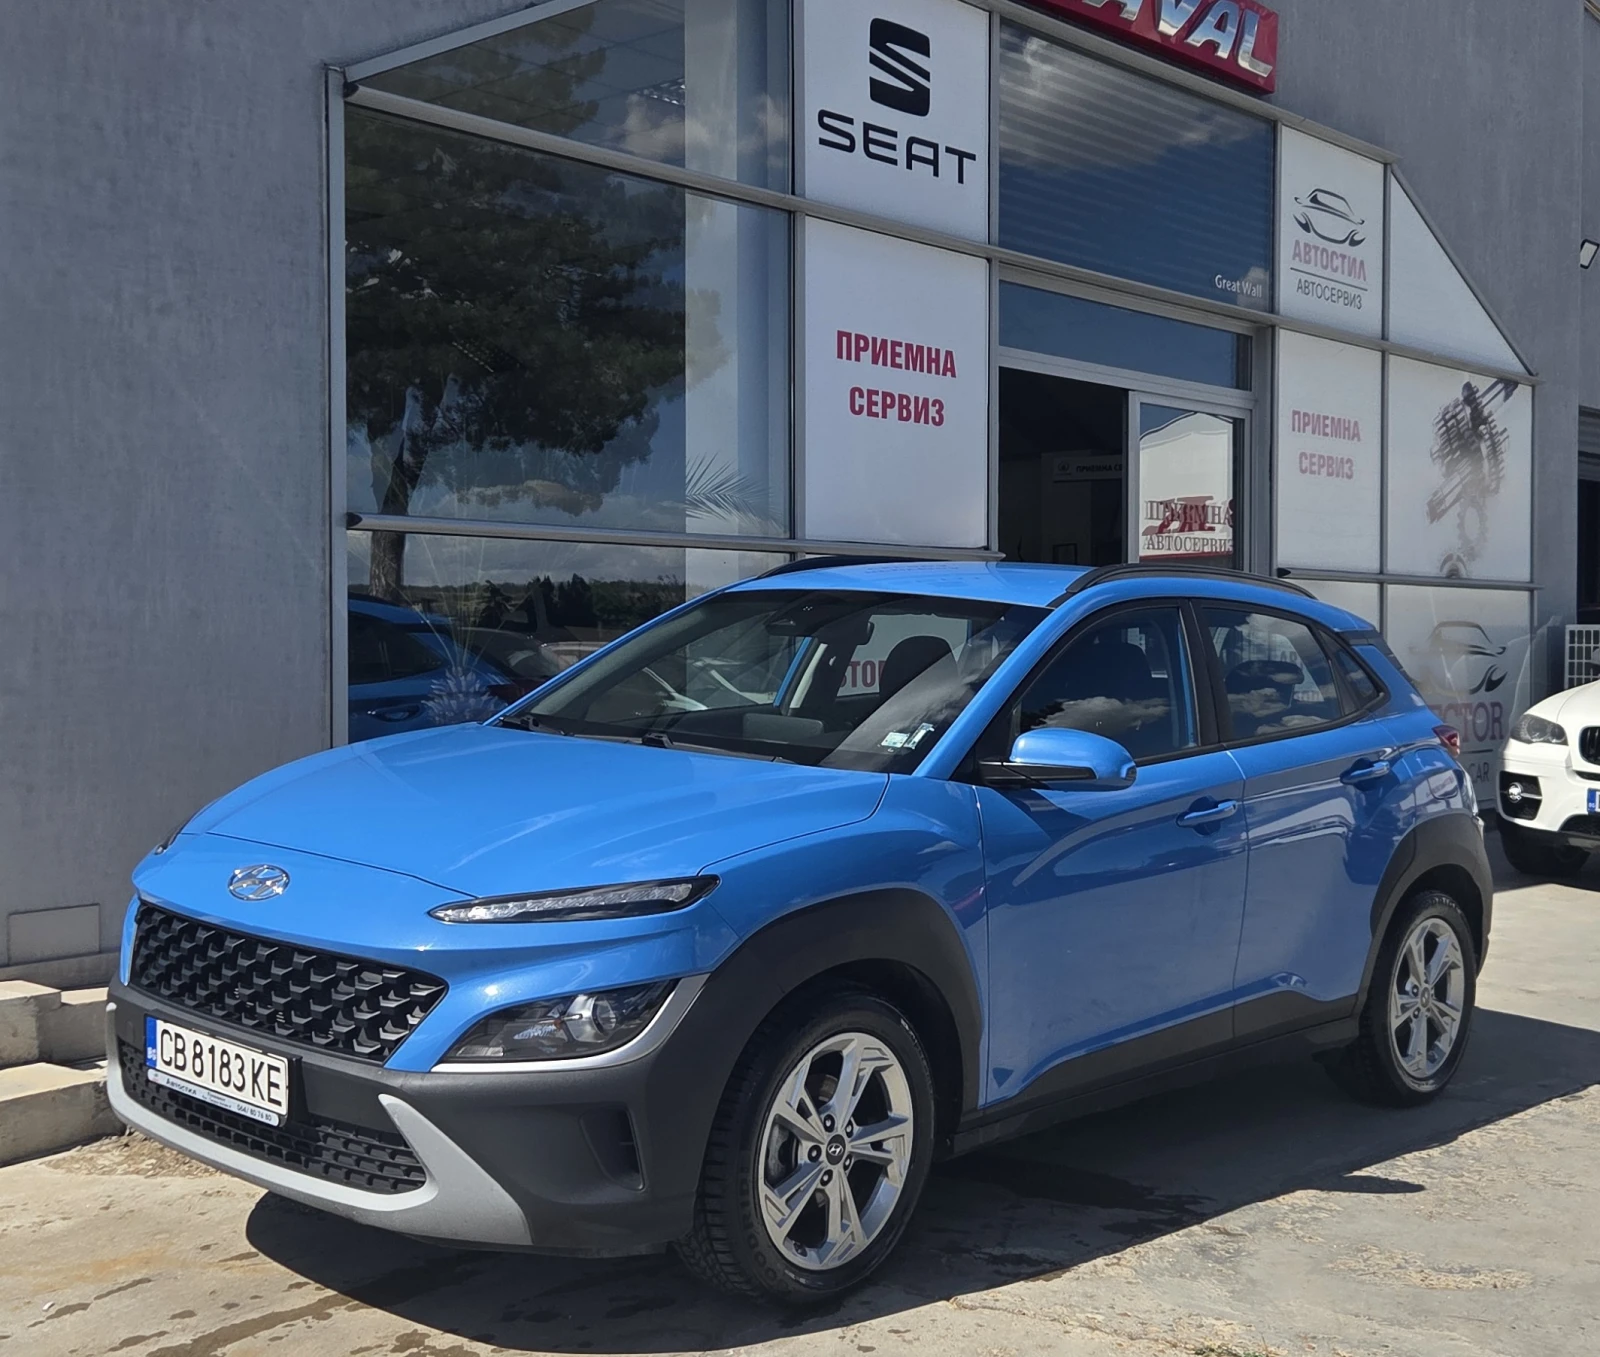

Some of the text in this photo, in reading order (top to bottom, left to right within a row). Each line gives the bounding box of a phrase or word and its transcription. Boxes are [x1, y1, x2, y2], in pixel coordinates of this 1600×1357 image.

[817, 108, 977, 185] SEAT
[1292, 239, 1367, 282] АВТОСТИЛ
[1214, 274, 1263, 298] Great Wall
[1296, 278, 1363, 310] АВТОСЕРВИЗ
[836, 330, 957, 379] ПРИЕМНА
[849, 386, 945, 427] СЕРВИЗ
[1291, 409, 1361, 442] ПРИЕМНА
[1298, 451, 1354, 480] СЕРВИЗ
